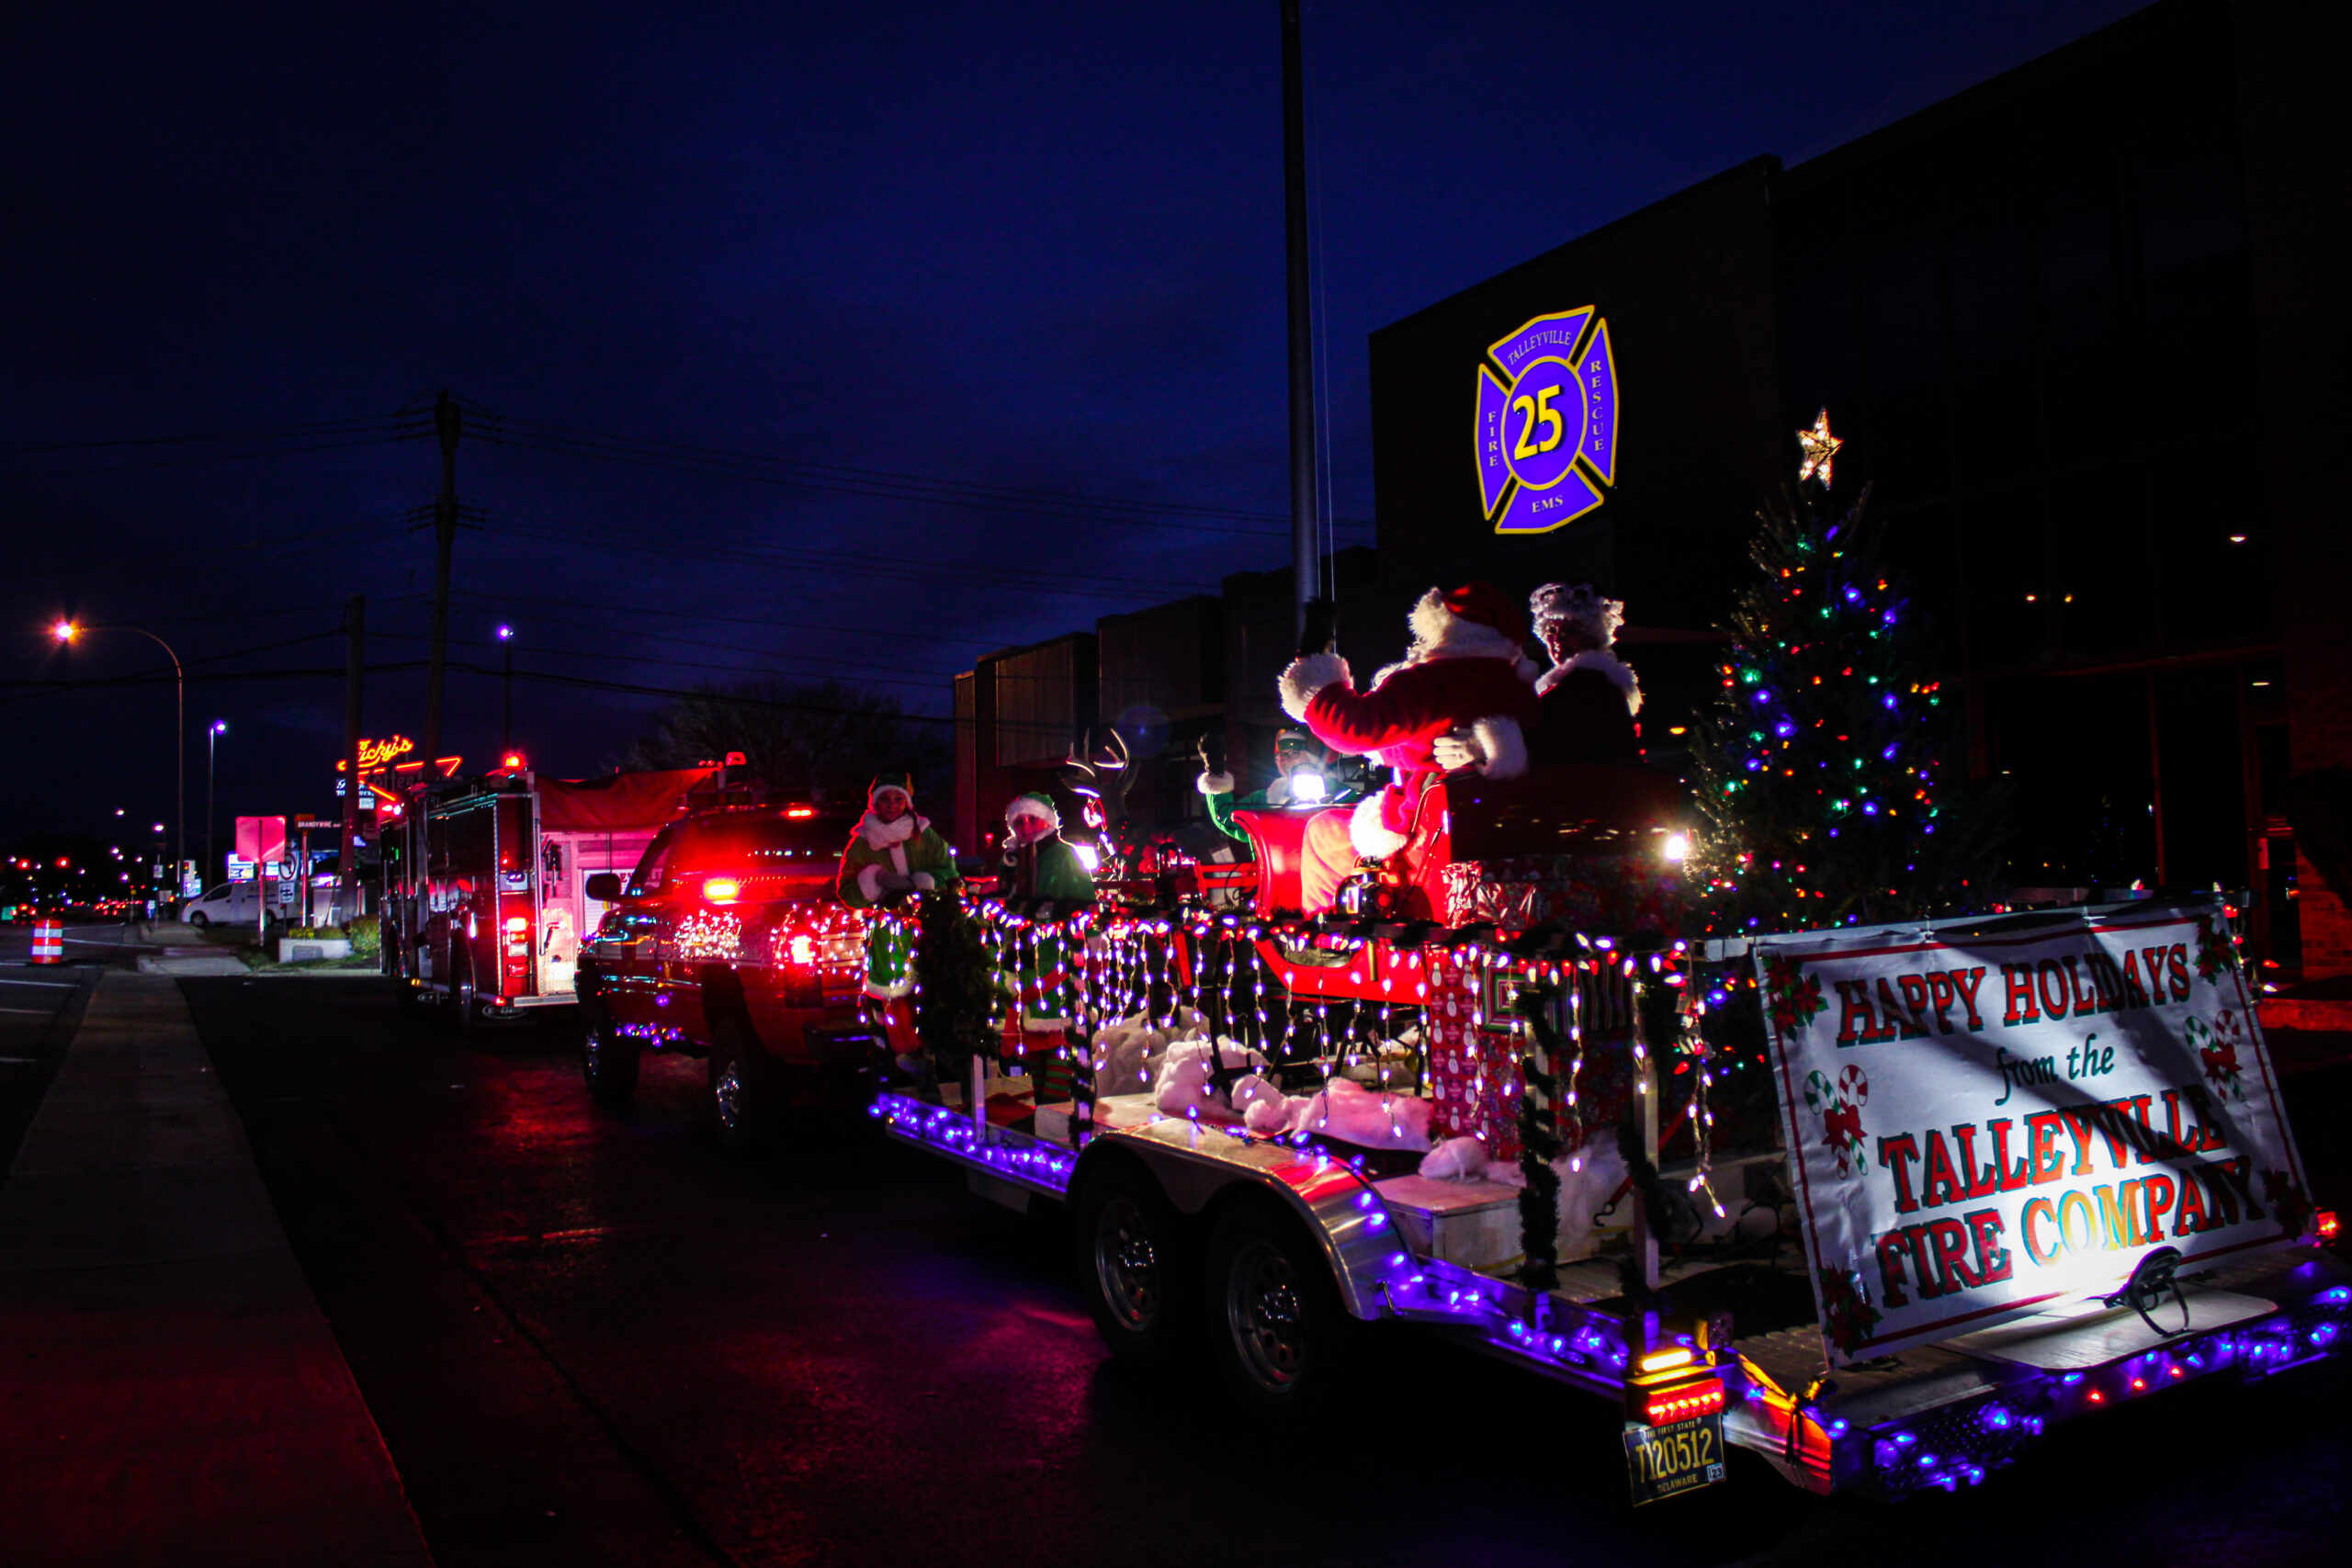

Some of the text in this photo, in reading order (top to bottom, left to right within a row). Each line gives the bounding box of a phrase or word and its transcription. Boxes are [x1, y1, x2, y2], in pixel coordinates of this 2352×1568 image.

[1507, 330, 1572, 367] TALLEYVILLE
[1512, 384, 1564, 460] 25
[1589, 360, 1605, 452] RESCUE
[1487, 411, 1498, 468] FIRE
[1532, 494, 1564, 513] EMS
[1836, 942, 2192, 1048] HAPPY HOLIDAYS
[1995, 1033, 2115, 1106] from the
[1878, 1085, 2230, 1214] TALLEYVILLE
[1870, 1155, 2267, 1310] FIRE COMPANY
[1635, 1427, 1715, 1484] T120512
[1657, 1425, 1675, 1436] FIRST
[1677, 1420, 1696, 1432] STATE
[1657, 1473, 1698, 1494] DELAWARE
